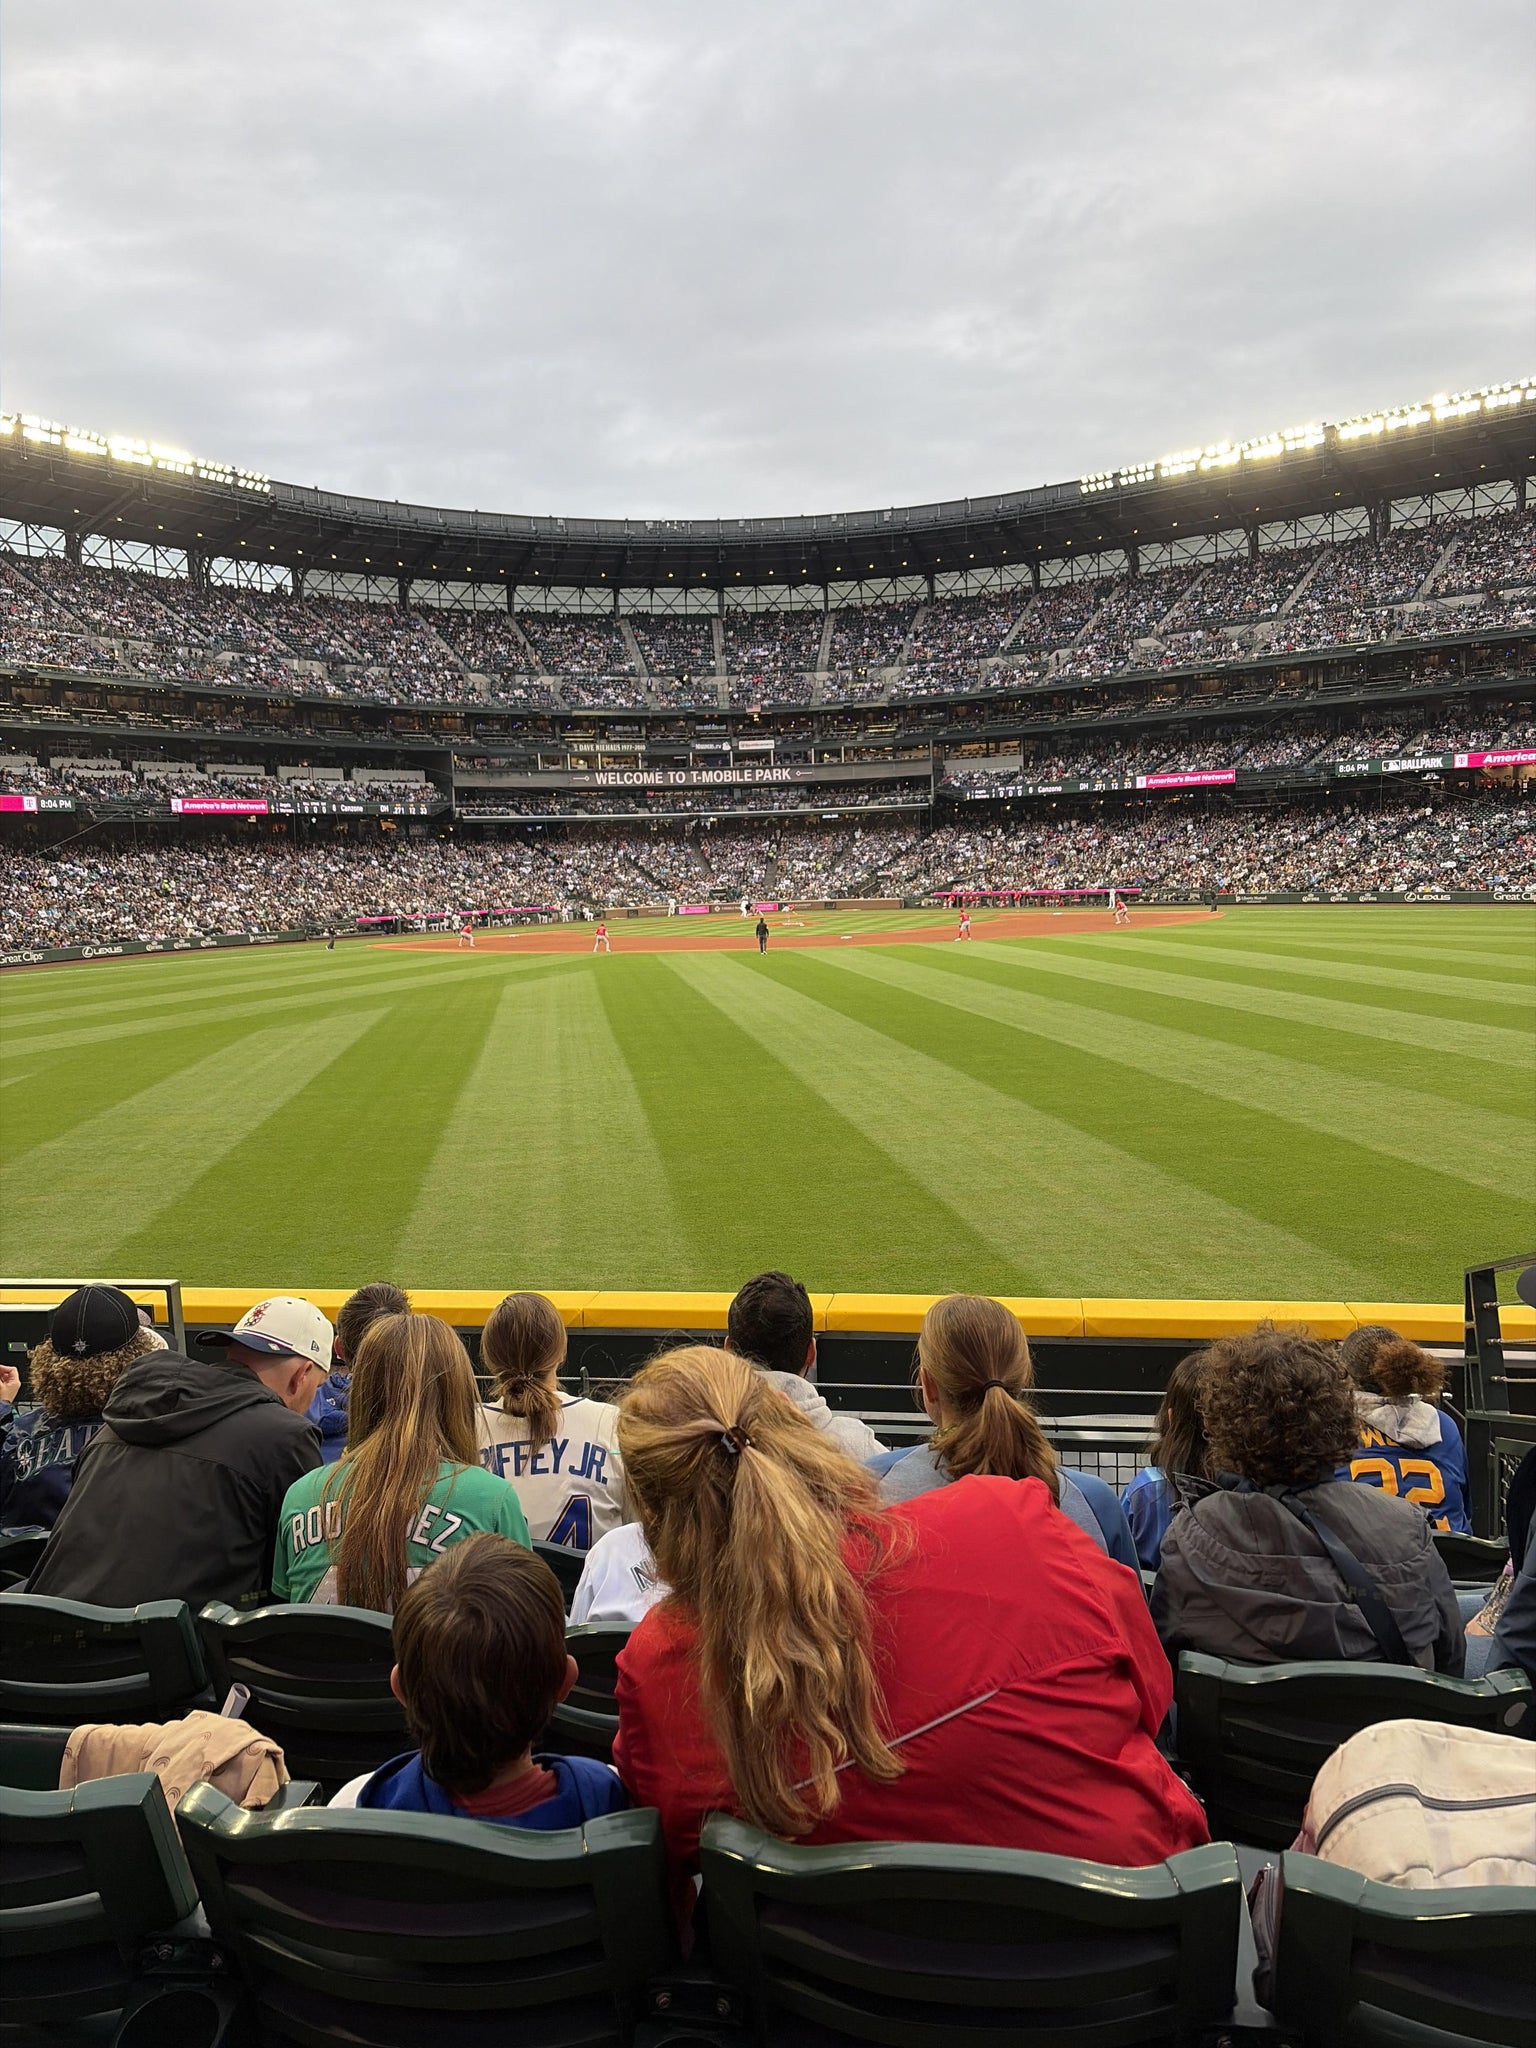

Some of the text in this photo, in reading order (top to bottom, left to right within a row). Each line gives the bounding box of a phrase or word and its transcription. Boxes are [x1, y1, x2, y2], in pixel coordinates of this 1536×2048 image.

[1339, 763, 1369, 773] 8:04 PM
[1401, 757, 1443, 770] BALLPARK
[595, 768, 791, 785] WELCOME TO T-MOBILE PARK
[1148, 776, 1184, 785] America's
[1201, 773, 1233, 782] Network
[1079, 782, 1089, 790] DH
[1111, 782, 1118, 790] 12
[1123, 781, 1132, 789] 33
[40, 799, 72, 808] 8:04 PM
[380, 804, 389, 813] DH
[1493, 892, 1520, 901] Great
[93, 946, 123, 955] LEXUS
[0, 951, 43, 964] Great Clips
[568, 1441, 608, 1485] JR.
